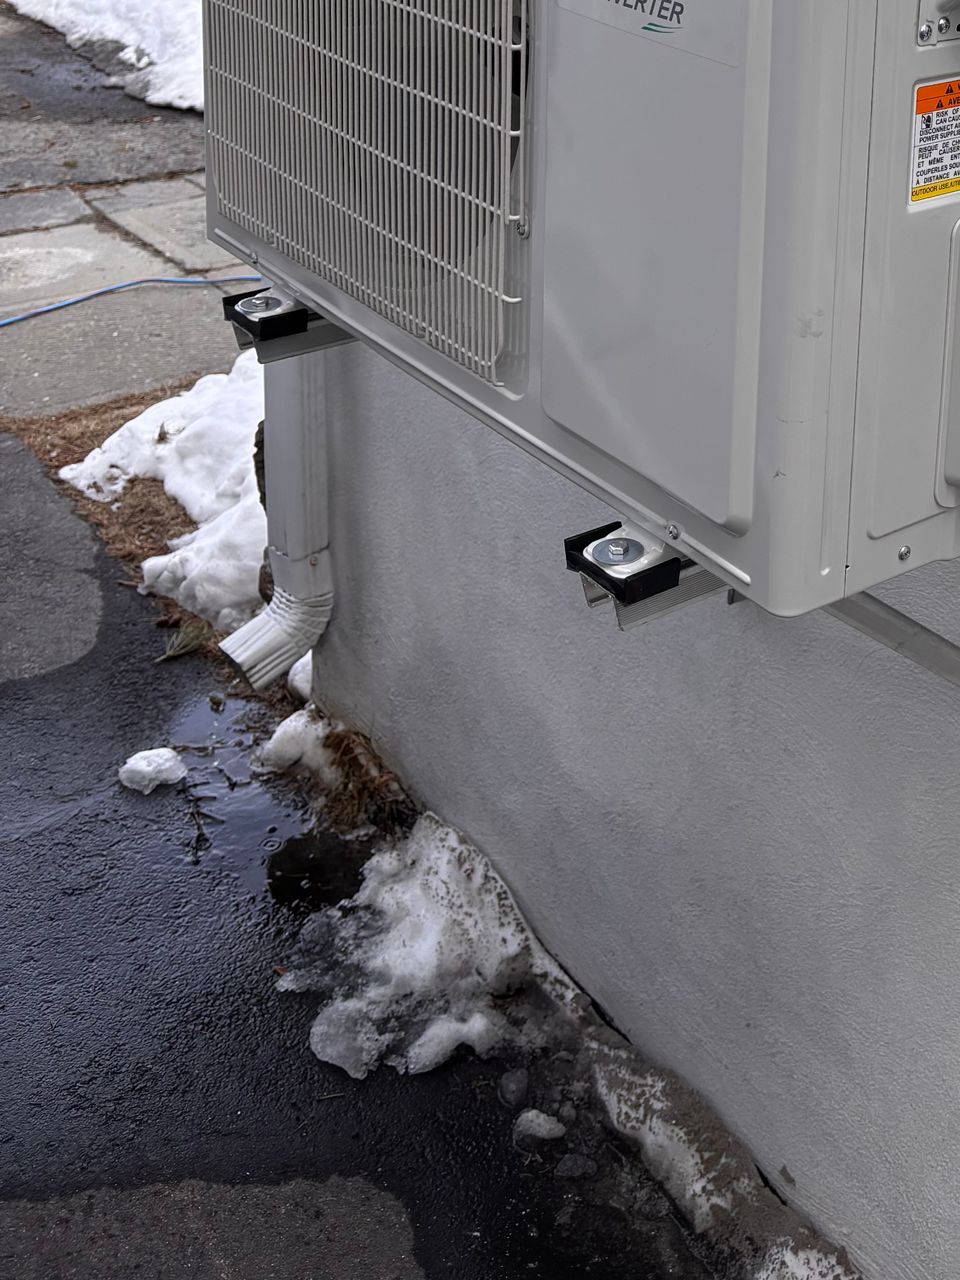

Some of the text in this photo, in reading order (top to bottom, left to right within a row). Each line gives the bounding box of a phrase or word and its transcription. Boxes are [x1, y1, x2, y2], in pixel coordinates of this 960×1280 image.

[919, 124, 953, 136] DISCONNECT
[919, 133, 939, 143] POWER
[918, 144, 938, 154] RISQUE
[918, 151, 932, 159] PEUT
[938, 145, 959, 155] CAUSER
[928, 155, 943, 165] MÊME
[923, 172, 949, 183] DISTANCE
[912, 185, 937, 196] OUTDOOR
